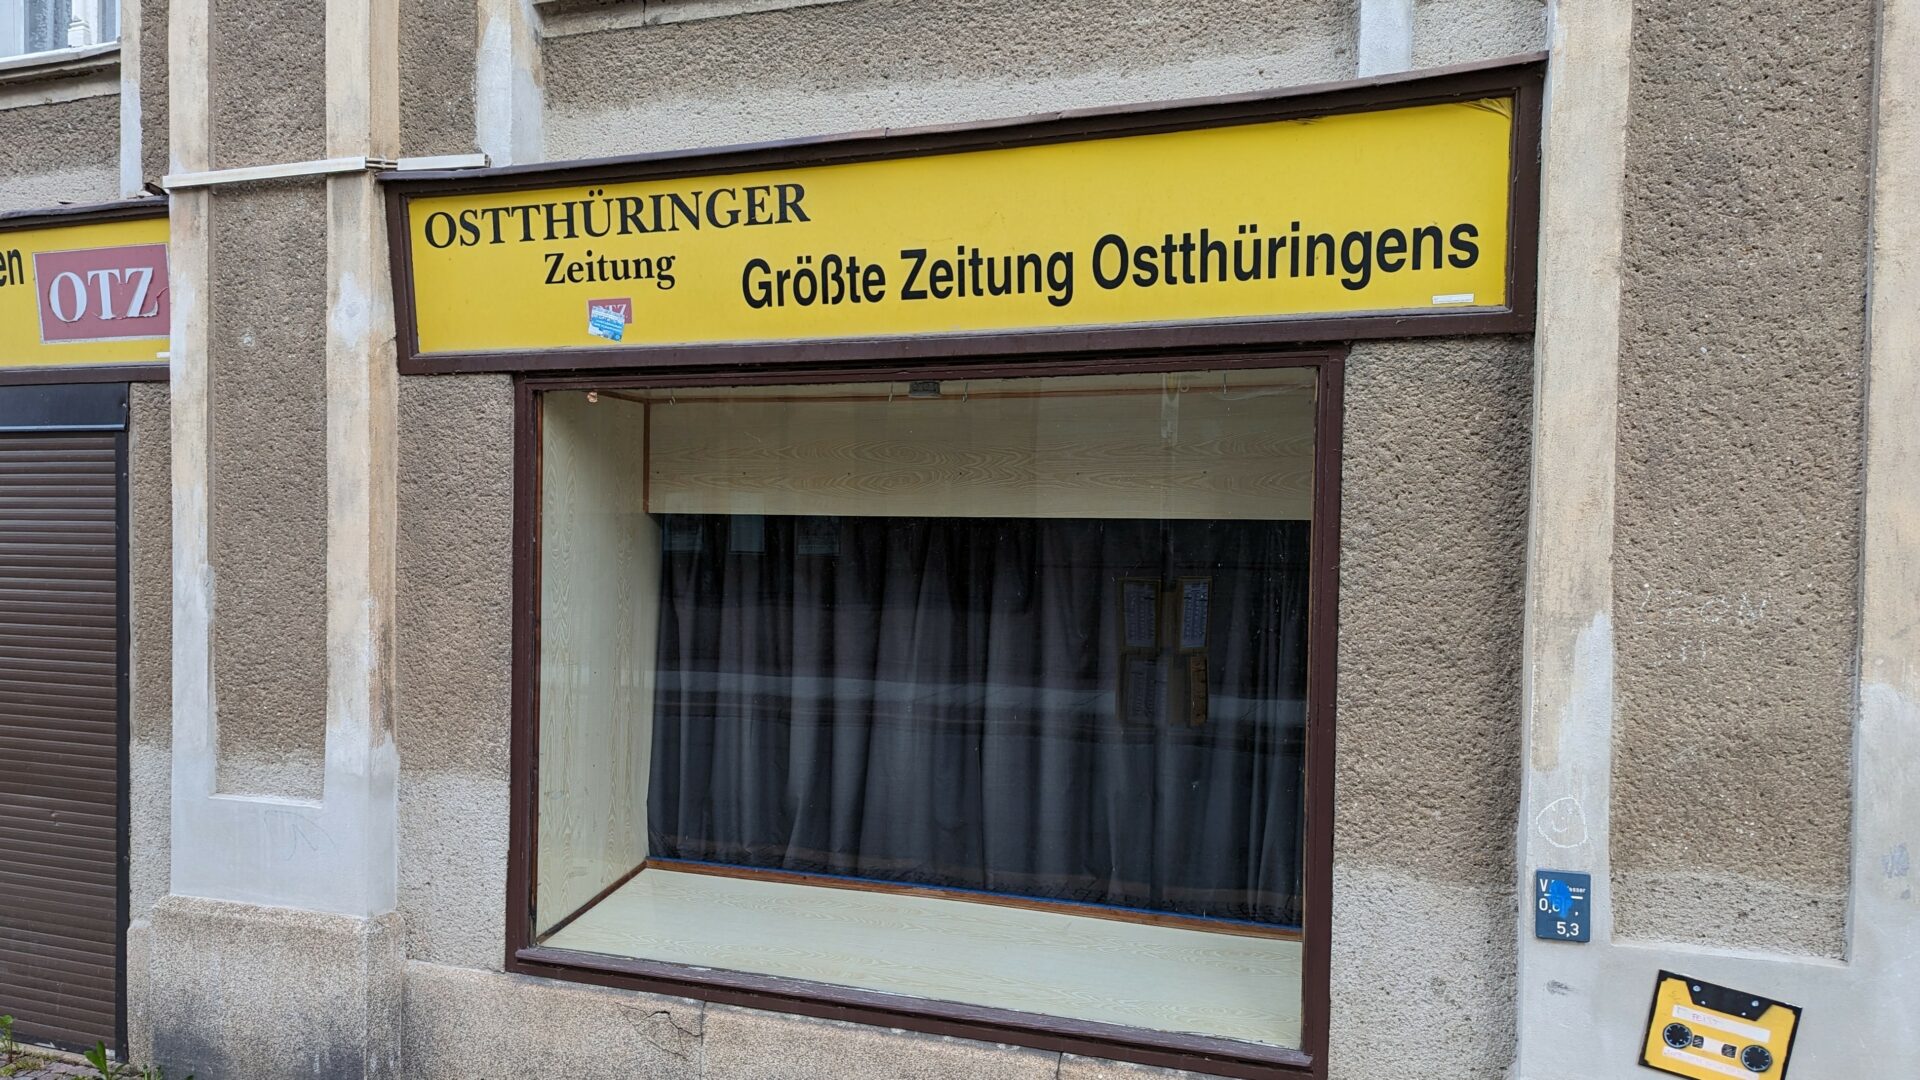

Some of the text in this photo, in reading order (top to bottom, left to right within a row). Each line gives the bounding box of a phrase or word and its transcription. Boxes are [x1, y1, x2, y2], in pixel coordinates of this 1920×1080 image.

[424, 183, 811, 249] OSTTHÜRINGER
[544, 250, 676, 290] Zeitung
[742, 222, 1479, 309] Größte Zeitung Ostthüringens
[48, 266, 159, 323] OTZ
[1556, 921, 1579, 938] 5,3
